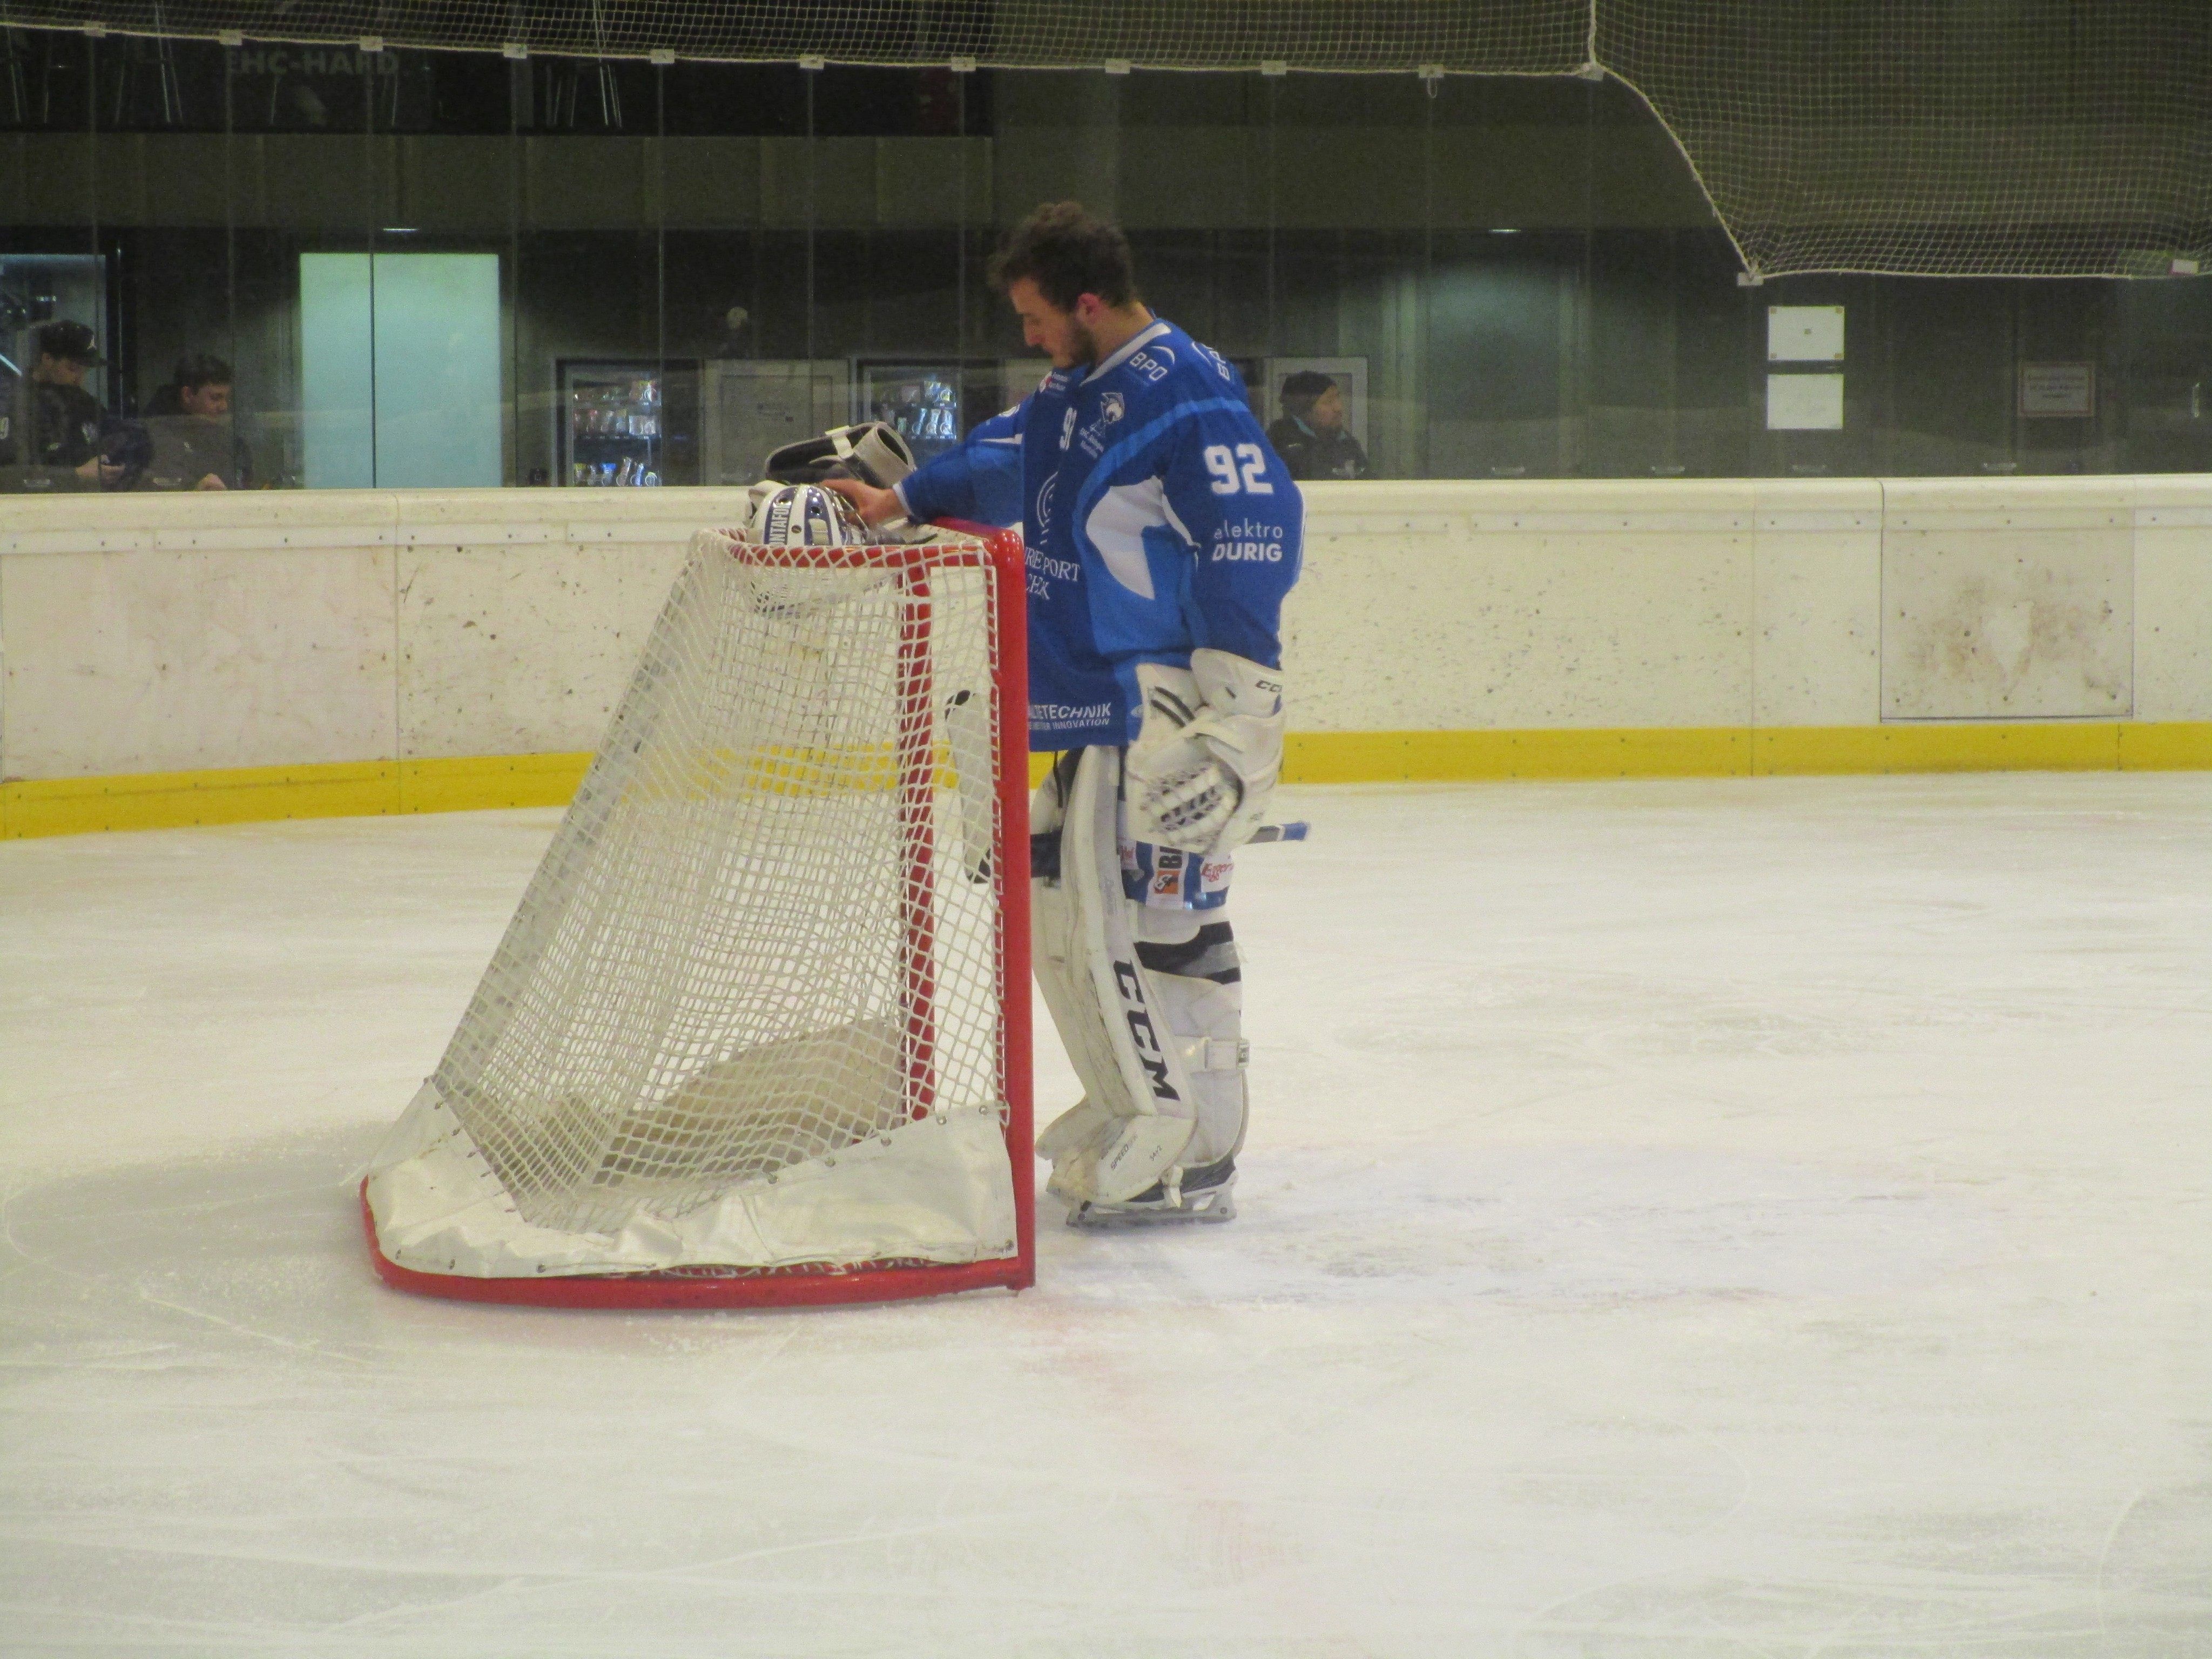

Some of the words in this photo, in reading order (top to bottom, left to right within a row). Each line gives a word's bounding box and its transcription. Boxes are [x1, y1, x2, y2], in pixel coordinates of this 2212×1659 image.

[1129, 352, 1168, 381] BPO
[1204, 443, 1274, 494] 92
[1215, 518, 1283, 539] elektro
[1212, 542, 1283, 562] DURIG
[1053, 718, 1110, 730] INNOVATION
[1113, 959, 1181, 1102] CCM
